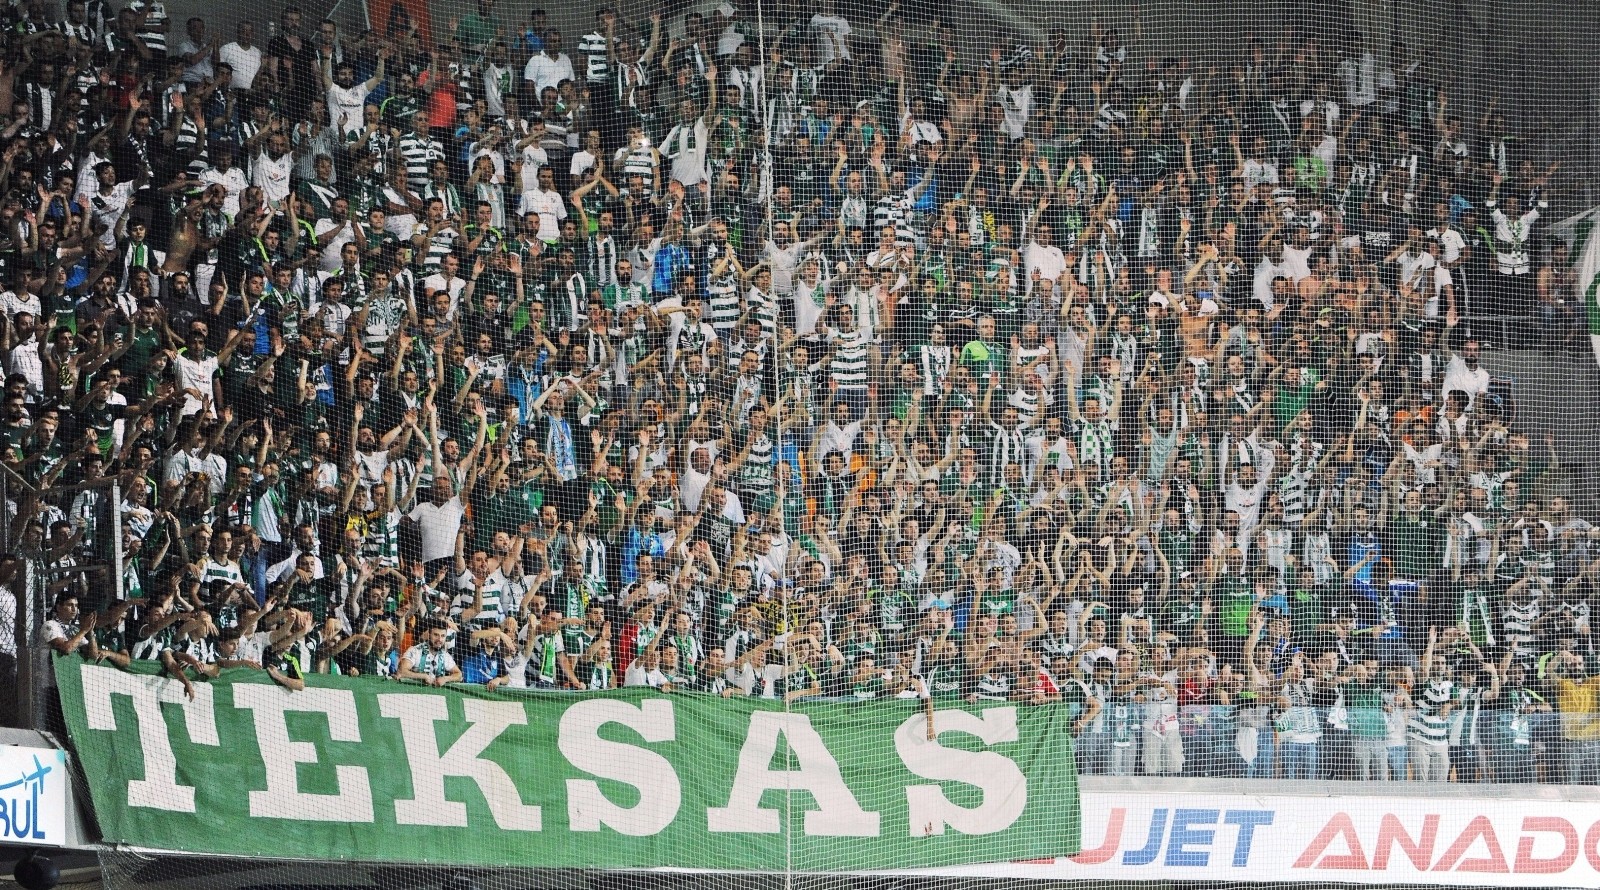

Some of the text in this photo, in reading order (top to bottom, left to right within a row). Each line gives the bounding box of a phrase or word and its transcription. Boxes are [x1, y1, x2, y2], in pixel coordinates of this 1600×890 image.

[80, 664, 1027, 836] TEKSAS
[1009, 807, 1274, 867] UJET
[1291, 812, 1600, 874] ANAD
